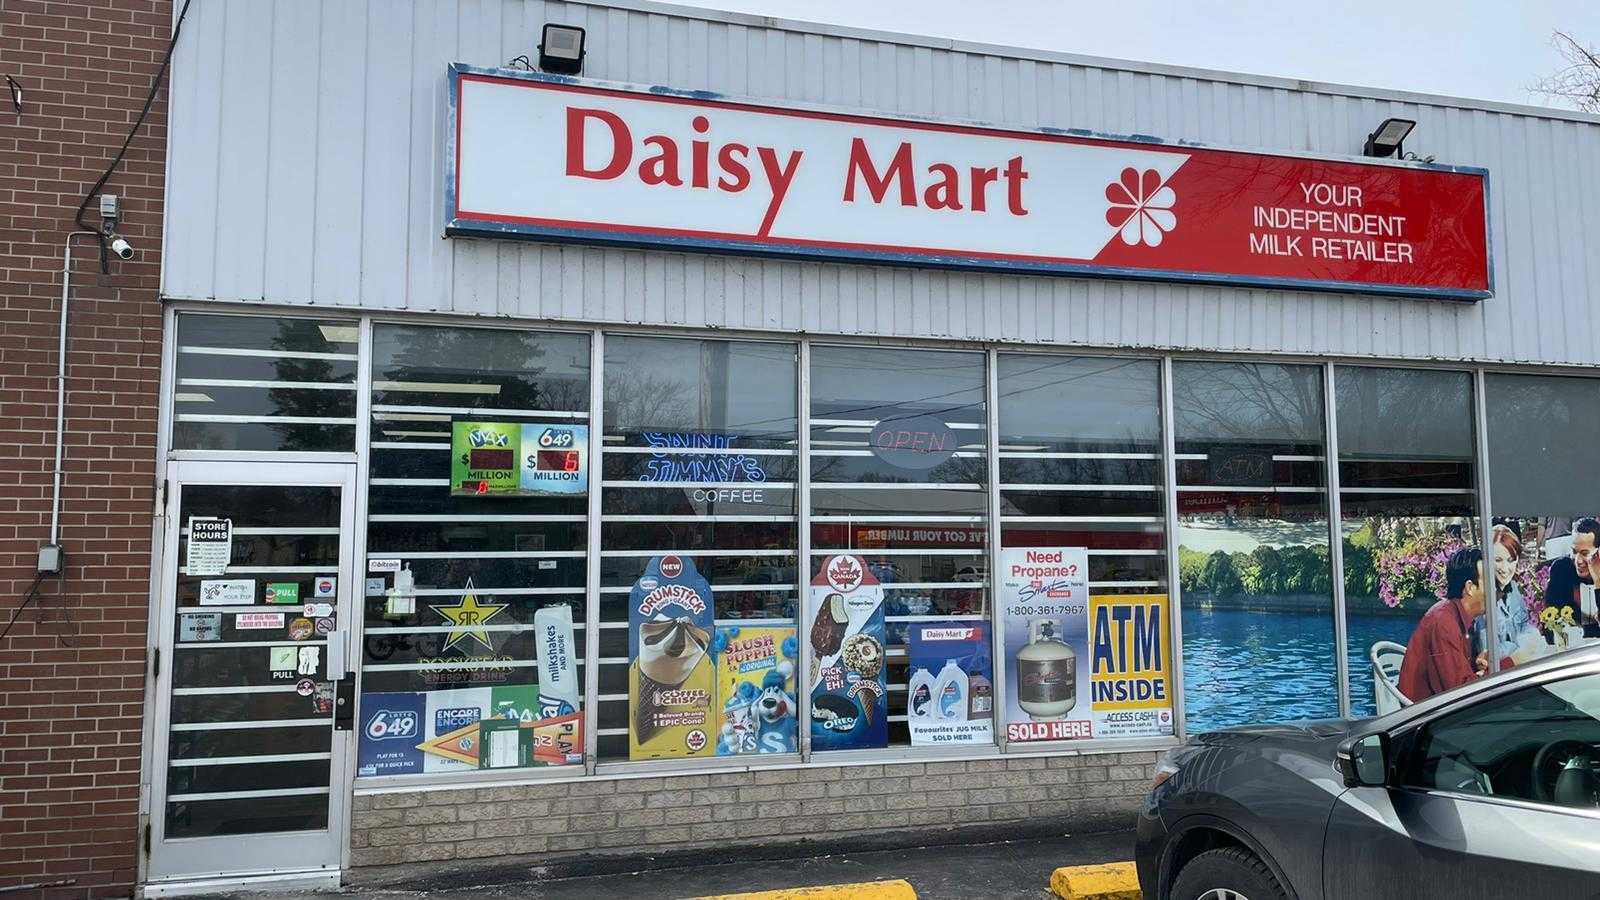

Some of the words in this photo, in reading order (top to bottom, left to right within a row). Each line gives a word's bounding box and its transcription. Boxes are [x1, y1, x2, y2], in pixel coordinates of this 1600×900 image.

[565, 105, 804, 239] Daisy
[843, 136, 1029, 216] Mart
[1300, 181, 1363, 208] YOUR
[1252, 205, 1407, 238] INDEPENDENT
[1248, 232, 1302, 257] MILK
[1311, 237, 1414, 264] RETAILER
[469, 430, 508, 447] MAX
[642, 432, 738, 458] SAINT
[876, 430, 946, 452] OPEN
[461, 454, 470, 466] $
[527, 454, 537, 469] $
[467, 471, 512, 480] MILLION
[639, 455, 767, 483] JIMMY'S
[533, 472, 579, 481] MILLION
[693, 489, 763, 502] COFFEE
[194, 523, 227, 531] STORE
[192, 531, 228, 539] HOURS
[1026, 550, 1063, 563] Need
[662, 563, 681, 571] NEW
[1011, 565, 1078, 580] Propane?
[276, 589, 297, 597] PULL
[639, 585, 705, 615] DRUMSTICK
[1006, 605, 1085, 616] 1-800-361-7967
[926, 630, 945, 639] Daisy
[945, 629, 962, 638] Mart
[1092, 604, 1163, 674] ATM
[558, 633, 566, 655] MORE
[724, 635, 774, 655] SLUSH
[545, 625, 561, 683] milkshakes
[726, 646, 776, 666] PUPPIE
[559, 655, 567, 670] AND
[272, 671, 294, 679] PULL
[425, 673, 469, 682] ENERGY
[472, 672, 506, 681] DRINK
[821, 667, 842, 677] PICK
[826, 680, 844, 691] EH!
[1091, 679, 1166, 703] INSIDE
[662, 689, 704, 698] COFFEE
[662, 696, 696, 705] CRISP
[437, 709, 479, 718] ENCORE
[1106, 712, 1133, 722] ACCESS
[1134, 711, 1154, 721] CASH
[660, 719, 680, 727] EPIC
[823, 717, 854, 730] OREO
[914, 726, 956, 734] Favourites
[1008, 723, 1048, 740] SOLD
[1050, 721, 1092, 738] HERE
[560, 723, 574, 754] PLAY
